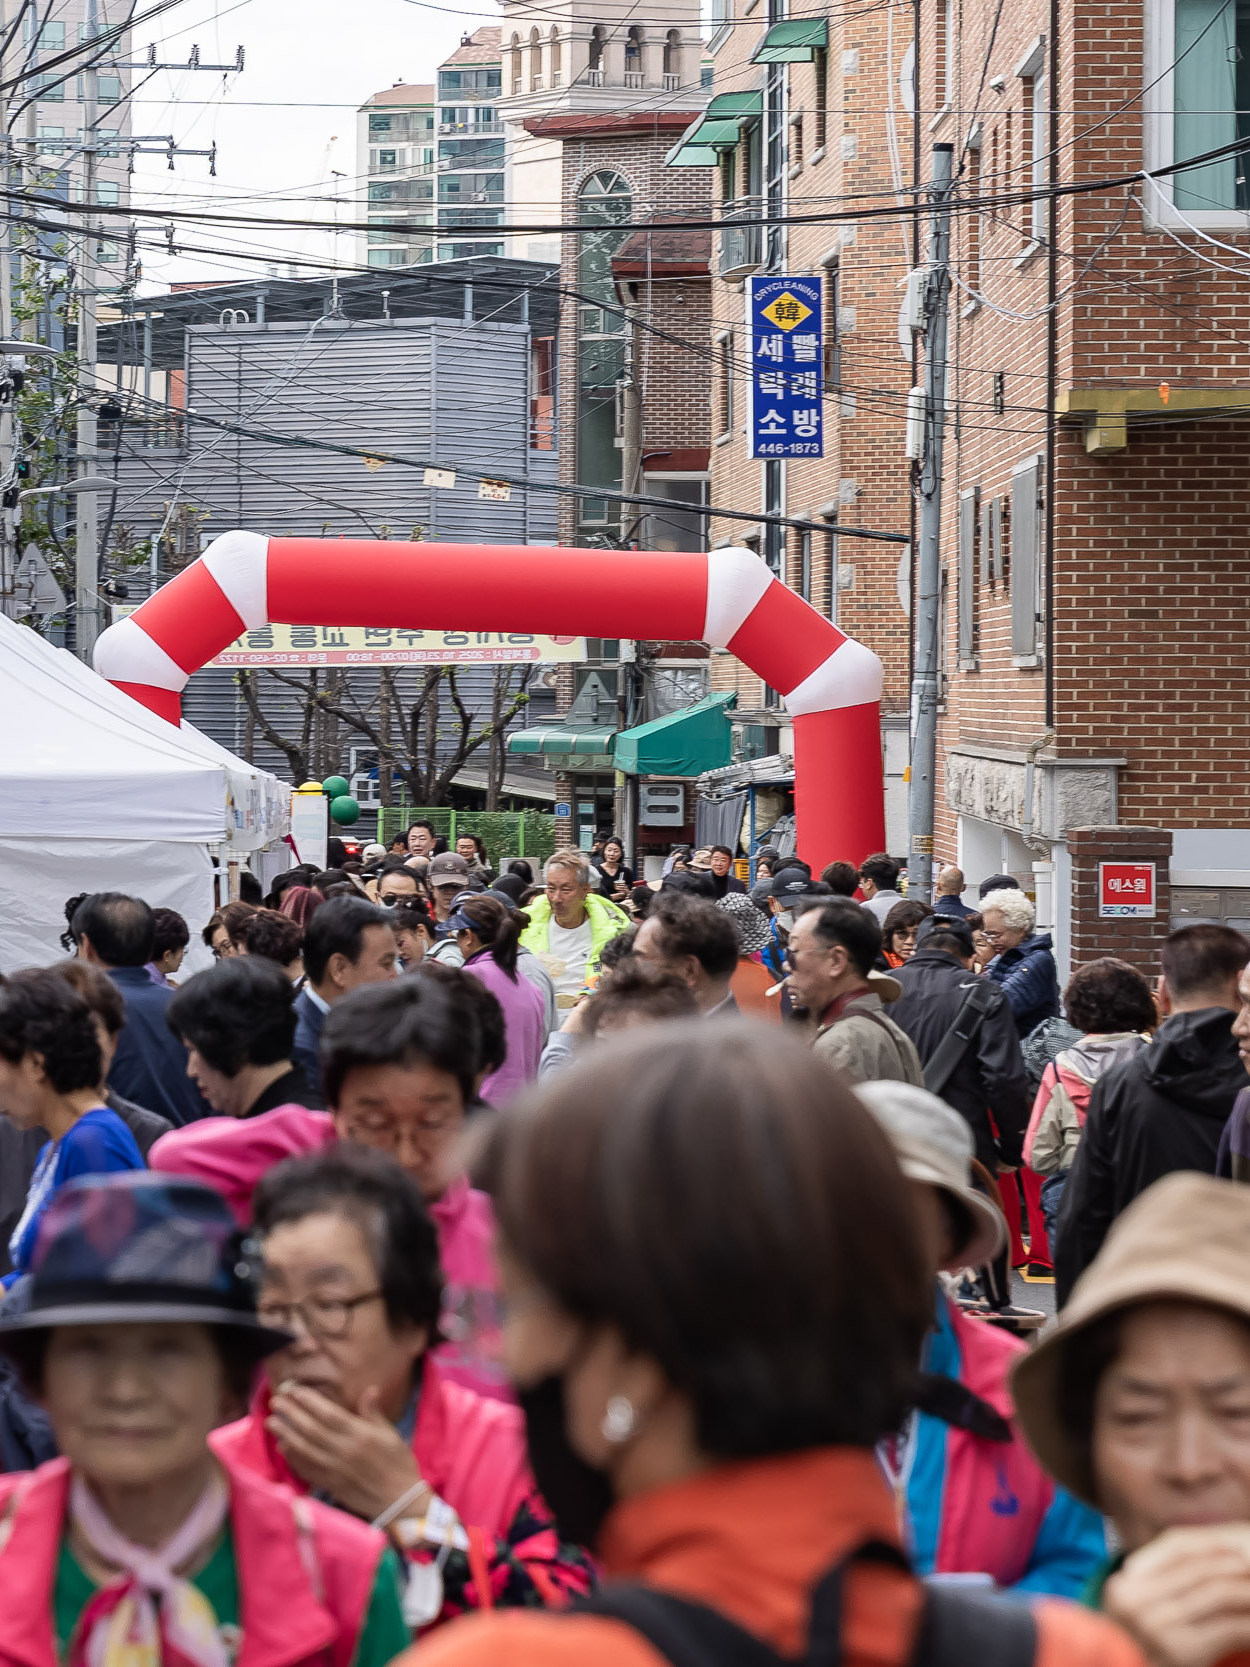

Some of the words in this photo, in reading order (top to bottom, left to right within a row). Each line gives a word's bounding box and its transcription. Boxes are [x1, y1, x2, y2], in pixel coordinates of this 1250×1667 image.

[774, 301, 801, 322] 韓
[757, 443, 820, 454] 446-1873
[1107, 878, 1147, 893] 에스원
